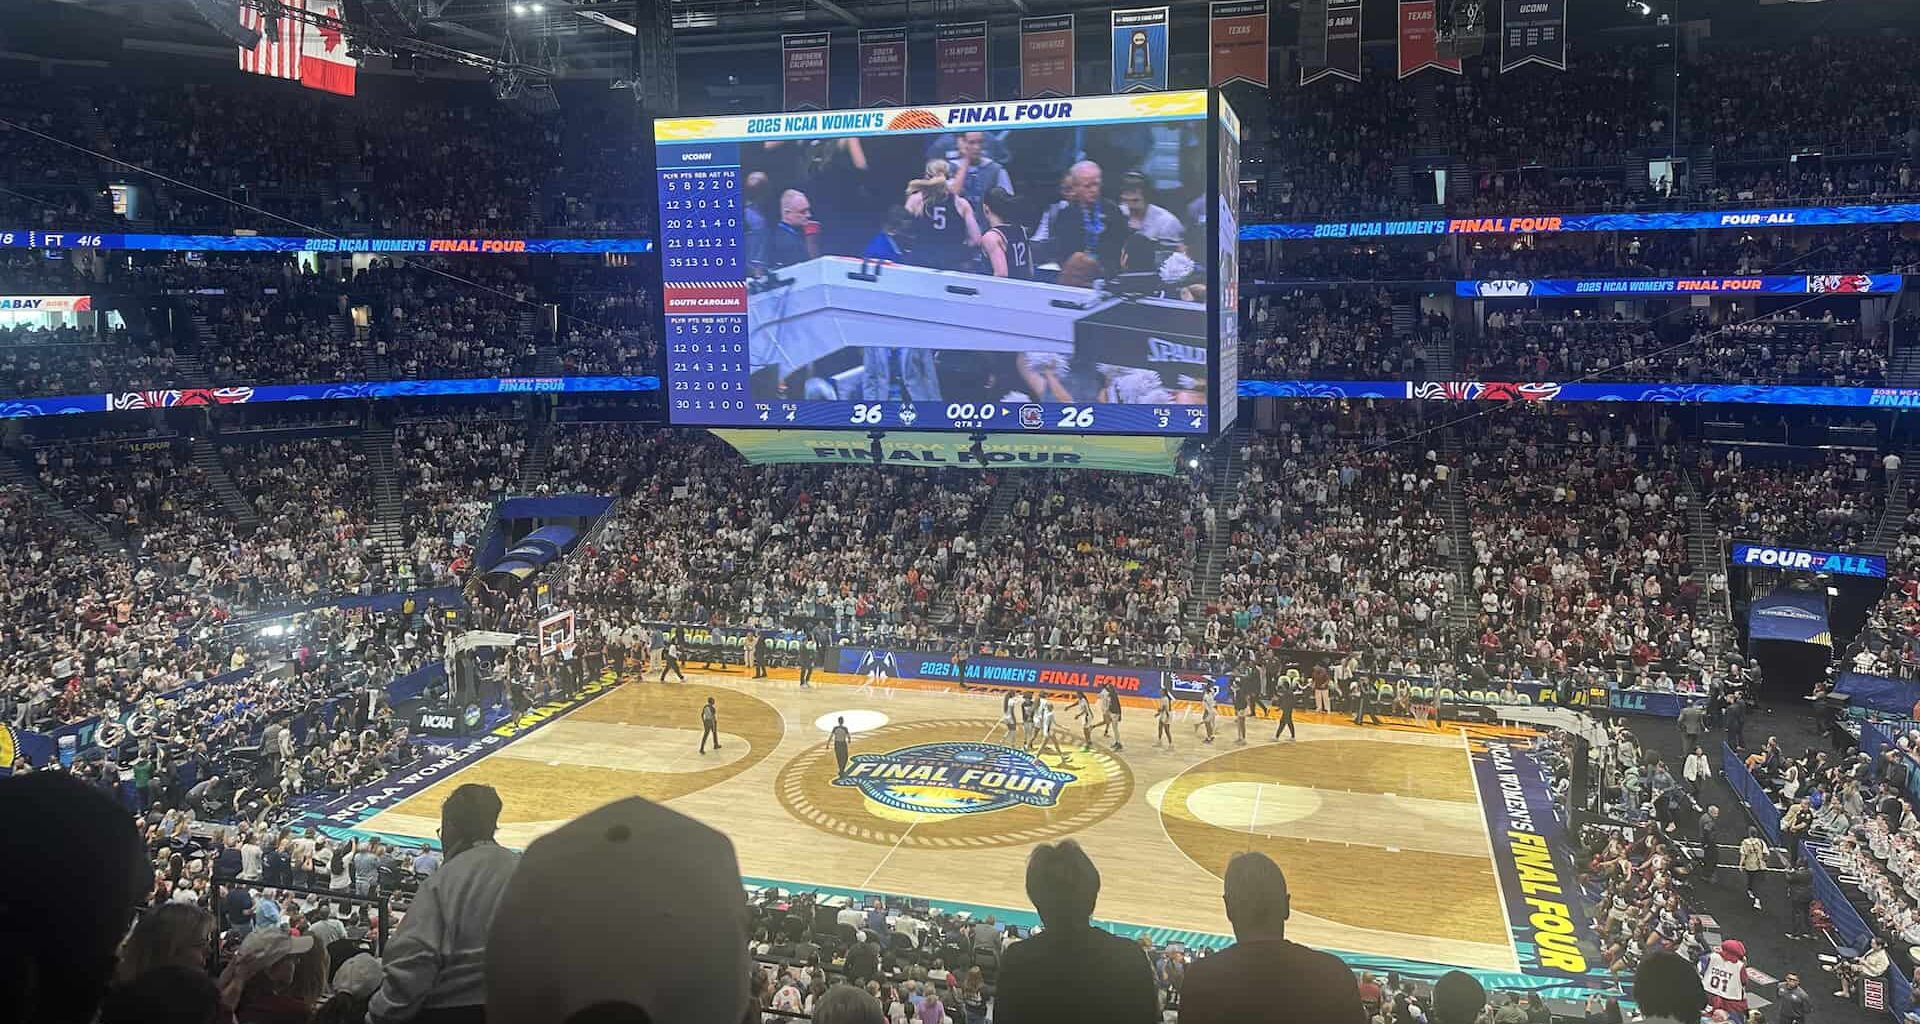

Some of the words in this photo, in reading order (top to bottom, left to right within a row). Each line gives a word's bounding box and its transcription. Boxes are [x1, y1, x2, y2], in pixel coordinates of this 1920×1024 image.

[1519, 4, 1548, 14] UCONN
[1408, 11, 1433, 21] TEXAS
[1228, 26, 1251, 35] TEXAS
[747, 117, 781, 133] 2025
[784, 115, 818, 132] NCAA
[821, 112, 884, 130] WOMEN'S
[947, 105, 1009, 124] FINAL
[1015, 102, 1073, 121] FOUR
[682, 152, 712, 161] UCONN
[668, 182, 676, 191] 5
[684, 182, 691, 190] 8
[698, 181, 705, 190] 2
[712, 181, 720, 189] 2
[726, 180, 734, 189] 0
[666, 201, 680, 210] 12
[685, 200, 692, 209] 3
[698, 200, 706, 208] 0
[713, 200, 720, 208] 1
[728, 199, 735, 208] 1
[667, 220, 681, 229] 20
[686, 220, 693, 229] 2
[700, 219, 707, 228] 1
[714, 219, 721, 228] 4
[728, 219, 736, 227] 0
[933, 206, 947, 230] 5
[1721, 214, 1760, 225] FOUR
[1766, 213, 1795, 224] ALL
[1313, 223, 1348, 238] 2025
[1350, 222, 1382, 237] NCAA
[1384, 220, 1445, 236] WOMEN'S
[1449, 218, 1505, 233] FINAL
[1509, 217, 1562, 232] FOUR
[44, 235, 64, 246] FT
[77, 235, 102, 246] 4/6
[304, 239, 337, 252] 2025
[338, 239, 369, 252] NCAA
[371, 239, 427, 251] WOMEN'S
[429, 239, 479, 252] FINAL
[482, 240, 526, 252] FOUR
[668, 239, 682, 248] 21
[687, 239, 694, 247] 8
[698, 239, 711, 247] 11
[715, 238, 722, 247] 2
[730, 238, 736, 247] 1
[1012, 242, 1026, 267] 12
[669, 258, 682, 267] 35
[686, 258, 698, 267] 13
[702, 258, 709, 267] 1
[716, 258, 723, 266] 0
[730, 258, 737, 266] 1
[1576, 282, 1602, 293] 2025
[1603, 281, 1628, 292] NCAA
[1629, 281, 1674, 292] WOMEN'S
[1677, 280, 1719, 291] FINAL
[1722, 279, 1762, 290] FOUR
[12, 299, 43, 309] BAY
[676, 325, 683, 334] 5
[691, 325, 698, 333] 5
[705, 325, 712, 334] 2
[719, 325, 726, 333] 0
[733, 325, 740, 333] 0
[673, 344, 687, 353] 12
[692, 344, 699, 353] 0
[706, 344, 713, 353] 1
[720, 344, 727, 353] 1
[734, 344, 741, 352] 0
[674, 363, 688, 372] 21
[692, 363, 700, 372] 4
[706, 363, 714, 372] 3
[721, 363, 728, 372] 1
[735, 363, 742, 372] 1
[498, 383, 533, 392] FINAL
[534, 382, 566, 391] FOUR
[675, 382, 689, 390] 23
[694, 382, 702, 390] 2
[707, 382, 715, 391] 0
[721, 382, 729, 391] 0
[735, 382, 743, 390] 1
[676, 400, 690, 409] 30
[695, 401, 701, 409] 1
[708, 401, 715, 409] 1
[722, 401, 730, 409] 0
[736, 401, 744, 410] 0
[755, 403, 771, 411] TOL
[759, 411, 769, 421] 4
[785, 411, 795, 421] 4
[850, 404, 882, 424] 36
[946, 404, 995, 419] 00.0
[1057, 406, 1095, 428] 26
[1153, 408, 1170, 416] FLS
[1158, 416, 1168, 427] 3
[1190, 417, 1201, 428] 4
[1745, 547, 1812, 568] FOUR
[1811, 556, 1826, 565] IT
[1823, 555, 1871, 574] ALL
[920, 661, 950, 676] 2025
[983, 665, 1038, 682] WOMEN'S
[1039, 670, 1090, 687] FINAL
[1093, 673, 1141, 691] FOUR
[1610, 690, 1647, 709] ALL
[420, 714, 456, 729] NCAA
[1487, 741, 1516, 771] NCAA
[328, 785, 405, 823] NCAA
[397, 735, 501, 785] WOMEN'S
[849, 762, 949, 782] FINAL
[958, 769, 1058, 797] FOUR
[1496, 773, 1536, 832] WOMEN'S
[1507, 831, 1562, 894] FINAL
[1525, 897, 1587, 973] FOUR
[1710, 976, 1729, 993] 01
[1864, 978, 1884, 1010] FIGHT
